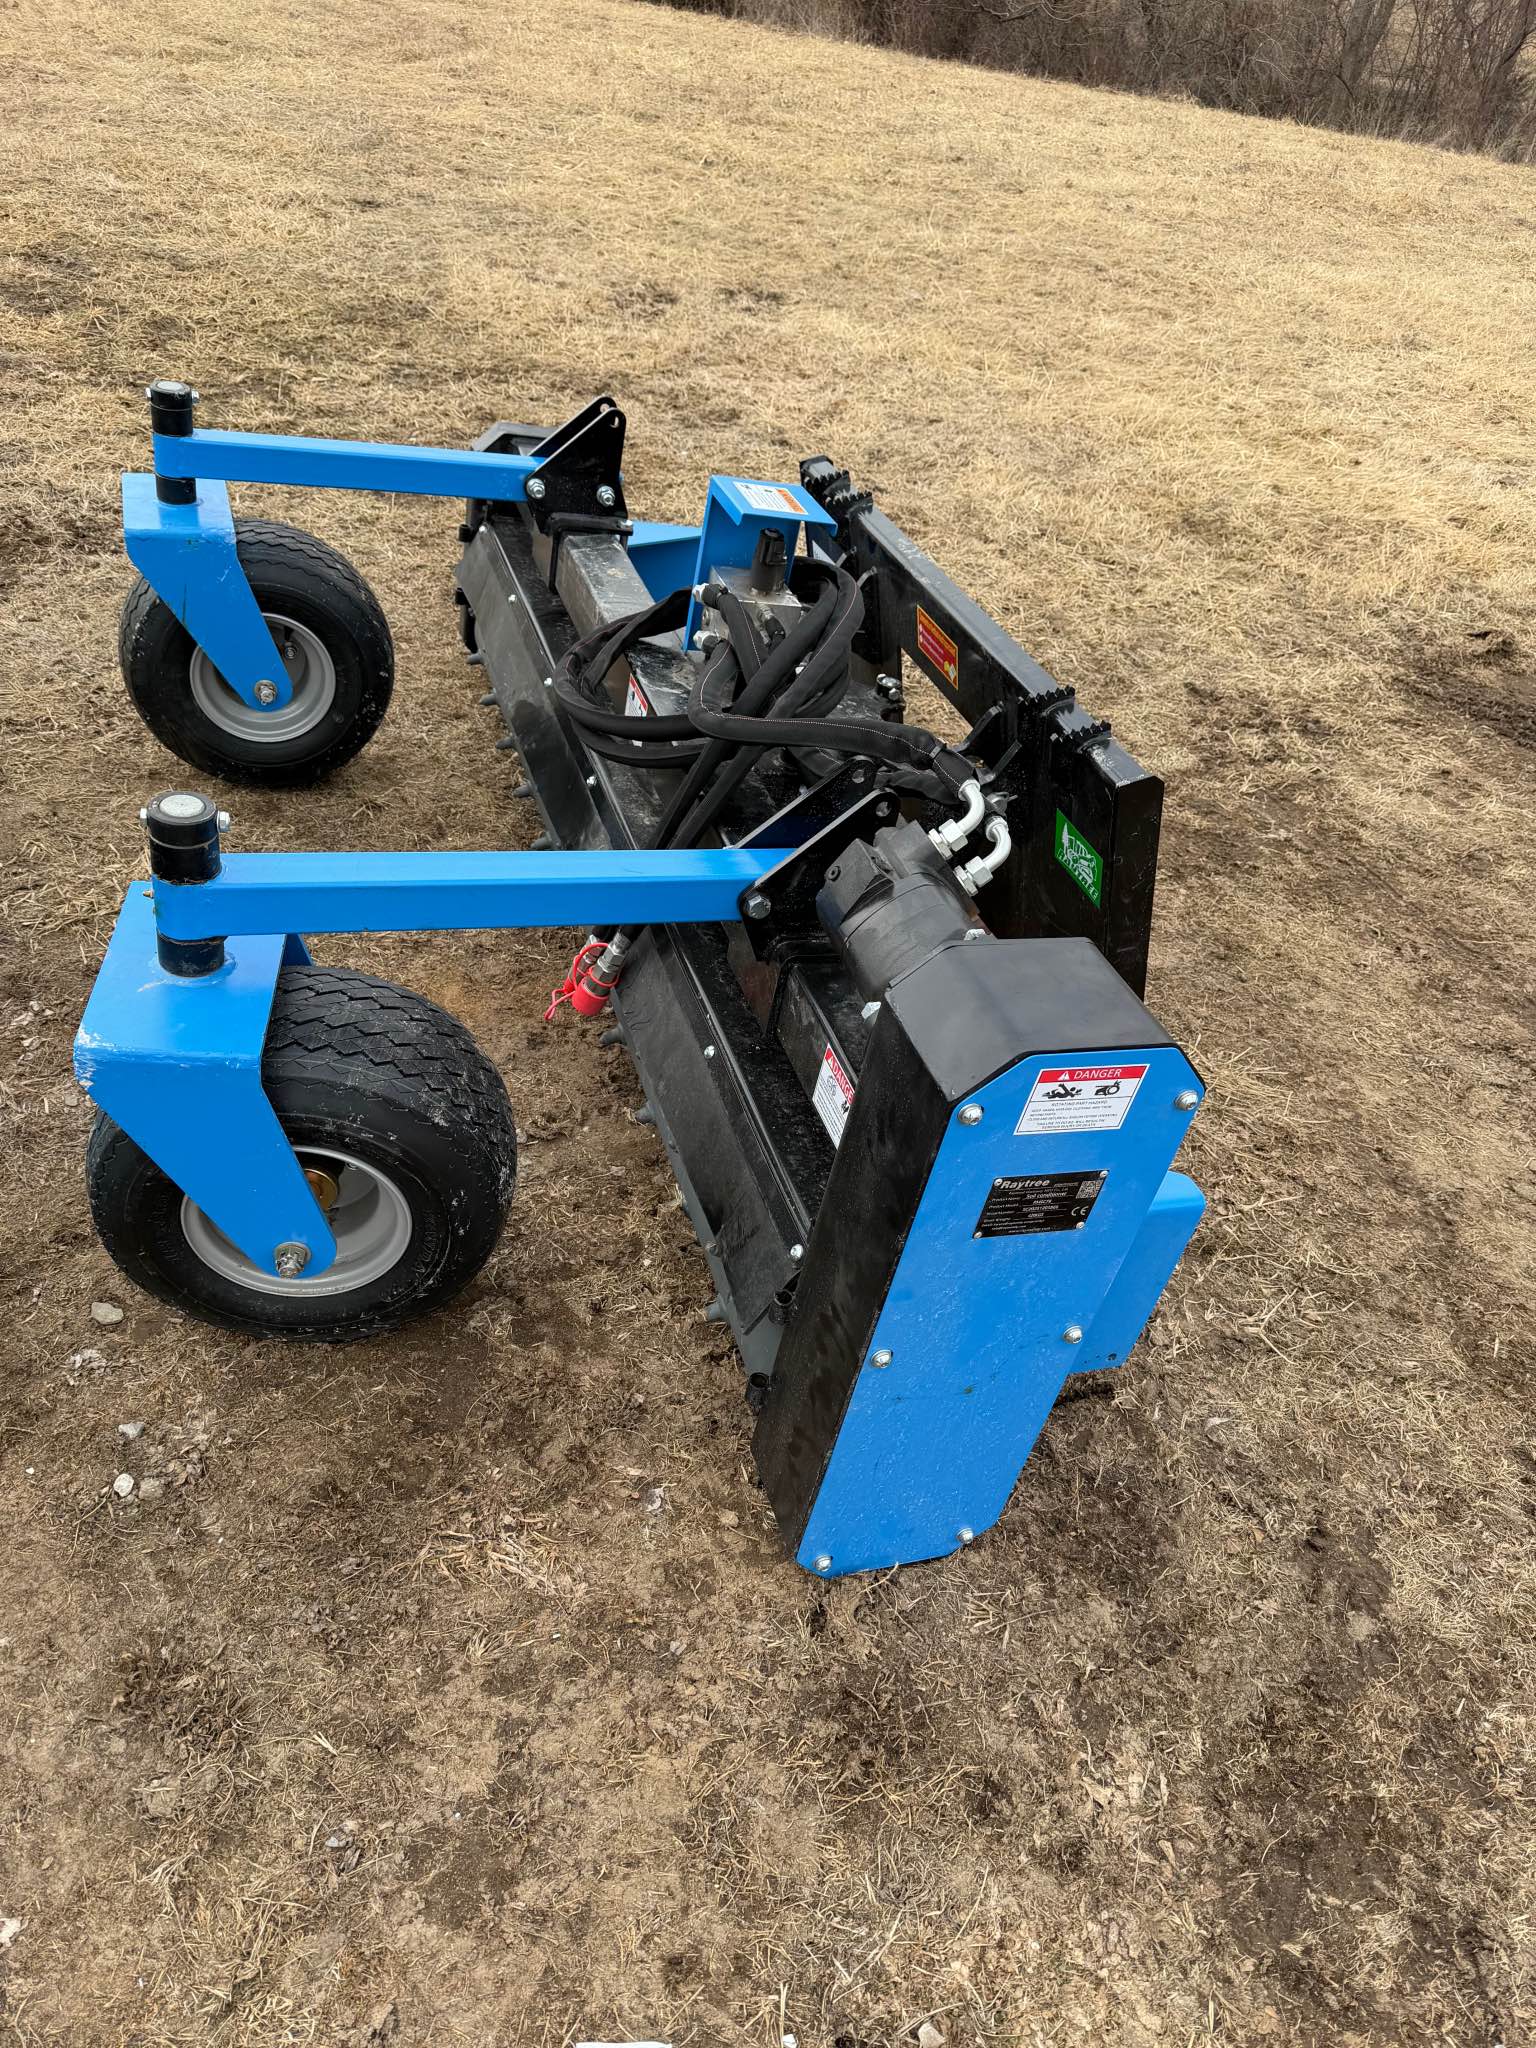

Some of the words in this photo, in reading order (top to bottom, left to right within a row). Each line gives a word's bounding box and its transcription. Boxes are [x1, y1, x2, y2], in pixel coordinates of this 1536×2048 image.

[1073, 1068, 1122, 1080] DANGER
[832, 1063, 855, 1105] DANGE
[1000, 1179, 1050, 1190] Raytree
